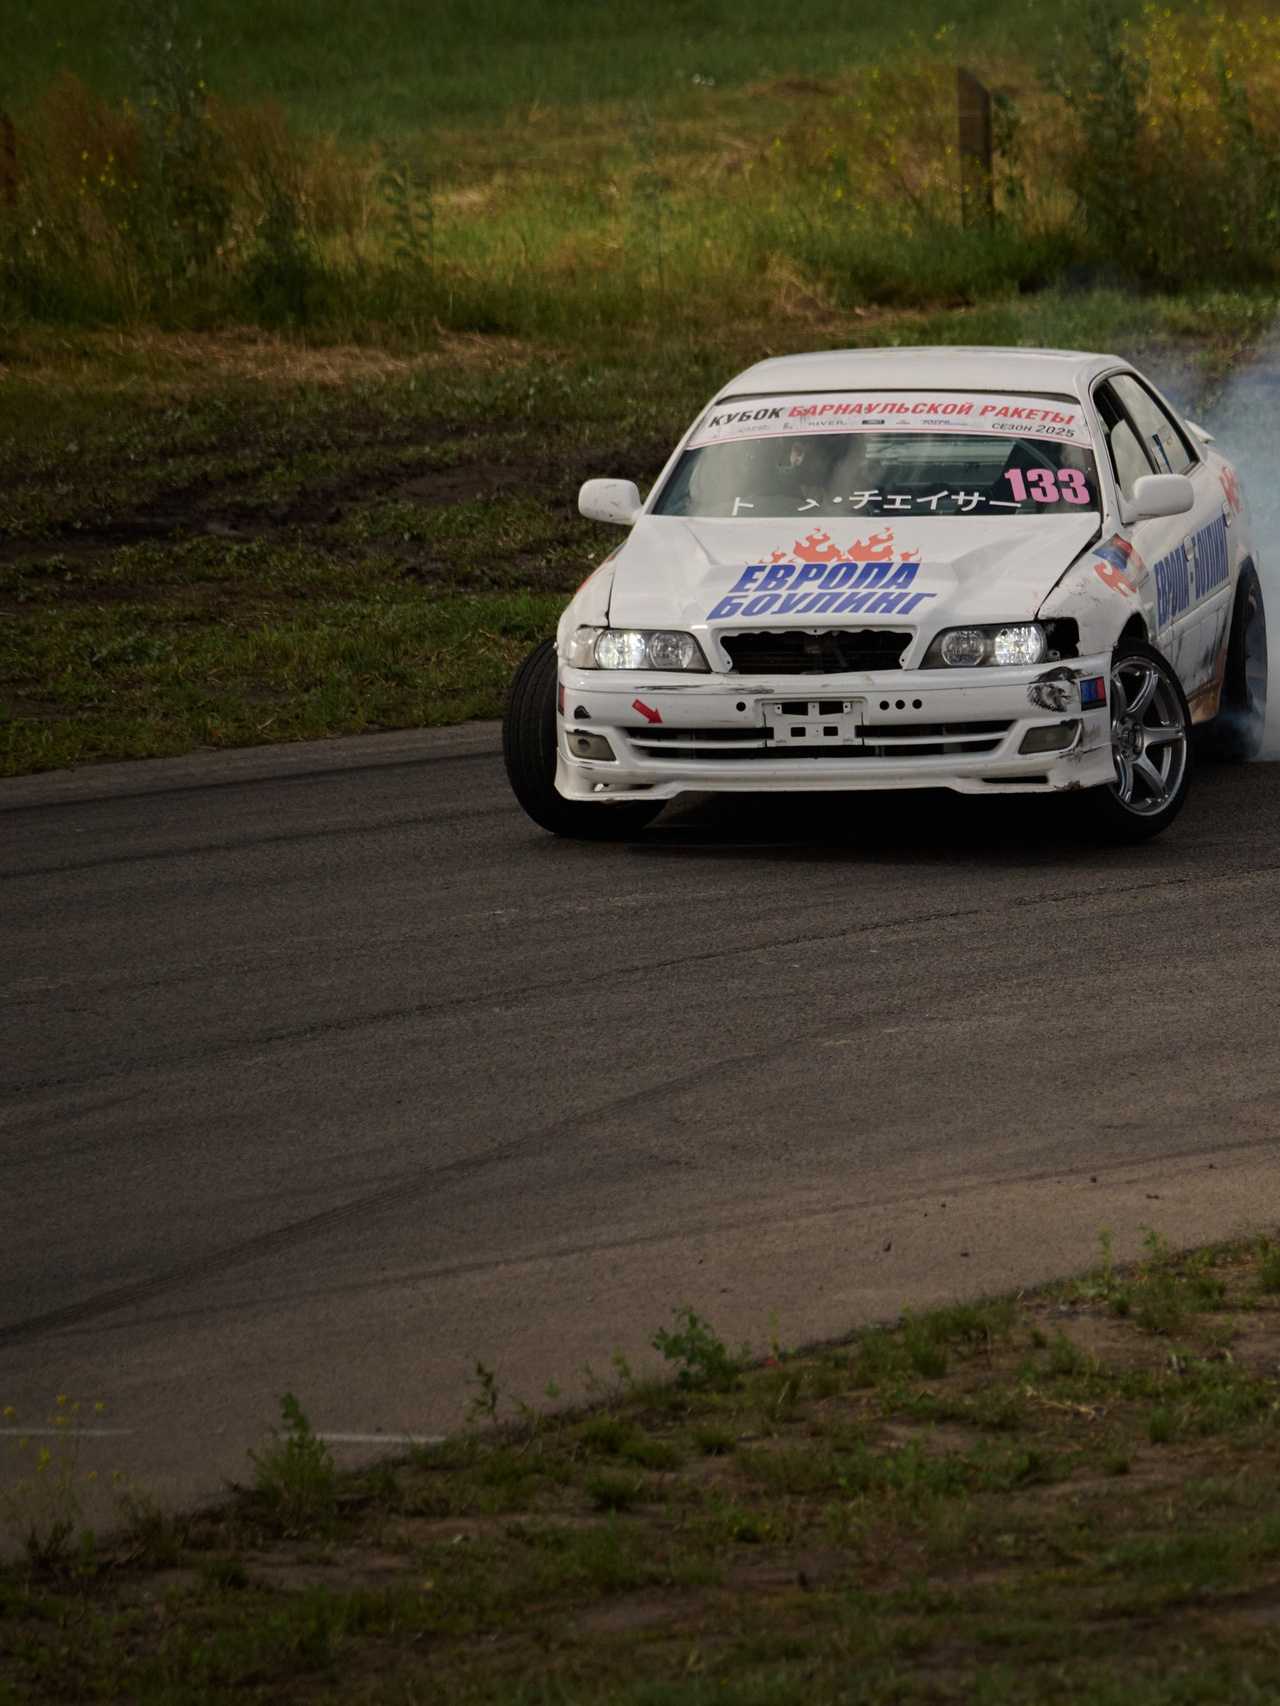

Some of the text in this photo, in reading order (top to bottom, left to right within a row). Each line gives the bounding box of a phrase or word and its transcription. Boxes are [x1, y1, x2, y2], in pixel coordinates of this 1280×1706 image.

[708, 406, 786, 428] КУБОК
[788, 402, 975, 418] БАРНАУЛЬСКОЙ
[979, 405, 1076, 425] РАКЕТЫ
[991, 422, 1077, 438] СЕЗОН 2025
[1004, 468, 1091, 505] 133
[728, 562, 921, 594] ЕВРОПА
[706, 592, 938, 621] БОУЛИНГ
